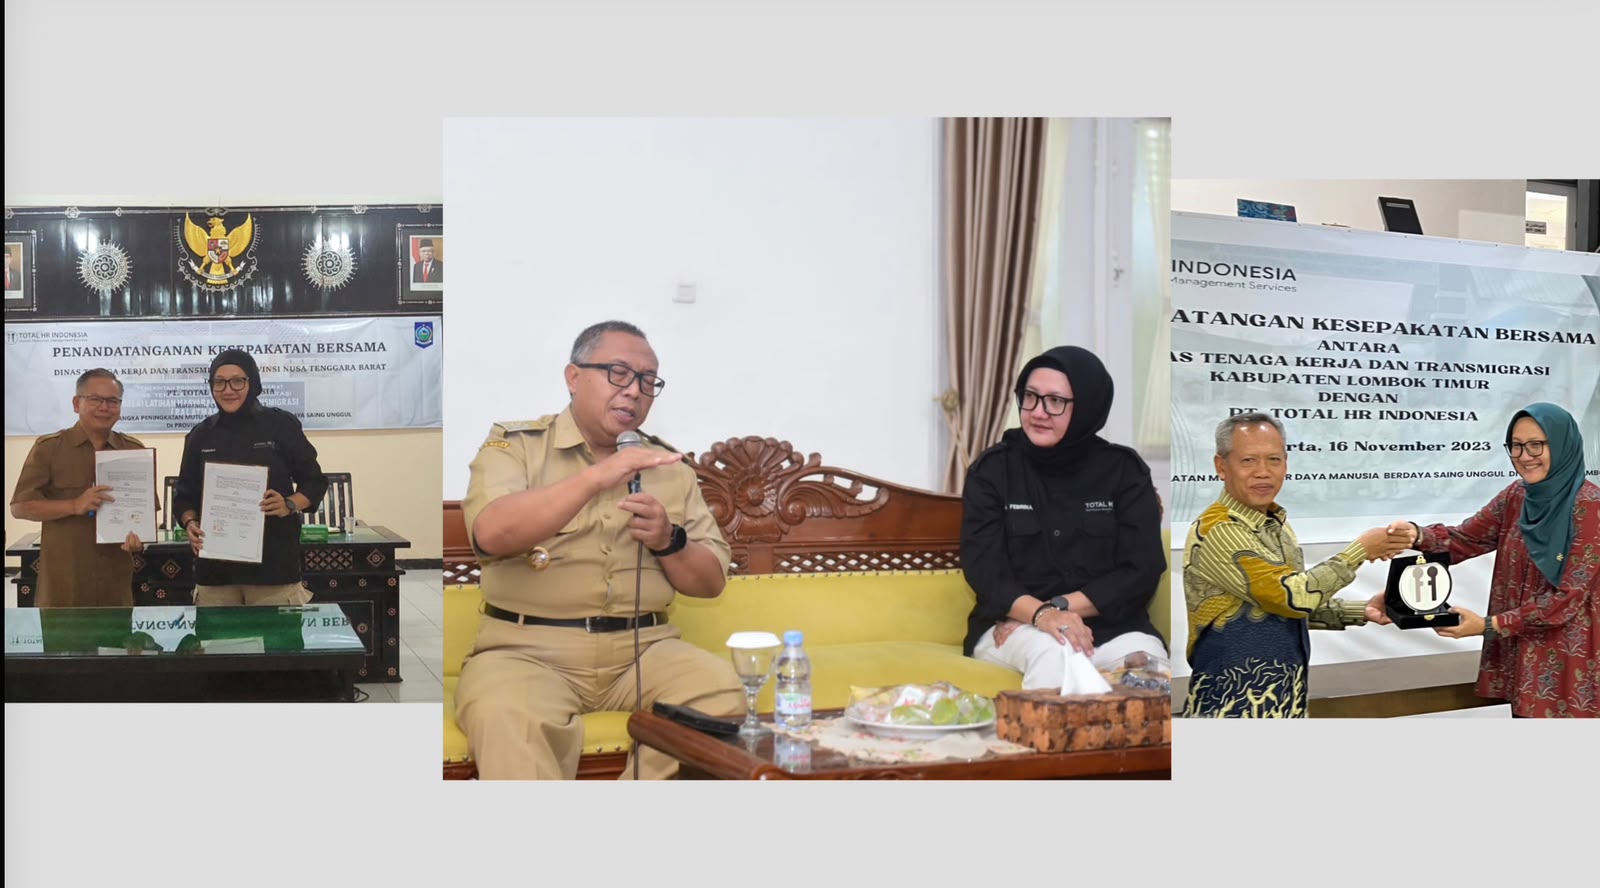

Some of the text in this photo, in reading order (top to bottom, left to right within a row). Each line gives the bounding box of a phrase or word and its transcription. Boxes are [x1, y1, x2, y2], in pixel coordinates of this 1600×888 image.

[1171, 259, 1297, 281] INDONESIA
[1248, 281, 1297, 292] Services
[1170, 309, 1597, 345] ATANGAN KESEPAKATAN BERSAMA
[53, 345, 203, 357] PENANDATANGANAN
[316, 342, 387, 353] BERSAMA
[1317, 339, 1401, 354] ANTARA
[54, 368, 81, 376] DINAS
[121, 368, 148, 376] KERJA
[150, 367, 169, 375] DAN
[283, 365, 307, 373] NUSA
[309, 364, 356, 372] TENGGARA
[359, 363, 387, 371] BARAT
[1200, 352, 1288, 366] TENAGA
[1295, 356, 1362, 369] KERJA
[1368, 359, 1409, 371] DAN
[1414, 361, 1551, 376] TRANSMIGRASI
[1210, 371, 1490, 390] KABUPATEN LOMBOK TIMUR
[1318, 392, 1399, 404] DENGAN
[1270, 408, 1338, 420] TOTAL
[1344, 409, 1372, 420] HR
[1379, 410, 1479, 421] INDONESIA
[1329, 441, 1348, 452] 16
[1354, 441, 1446, 452] November
[1451, 441, 1491, 452] 2023
[1171, 474, 1206, 482] ATAN
[1384, 471, 1432, 480] BERDAYA
[1433, 470, 1464, 479] SAING
[1466, 470, 1505, 478] UNGGUL
[1085, 500, 1108, 509] TOTAL
